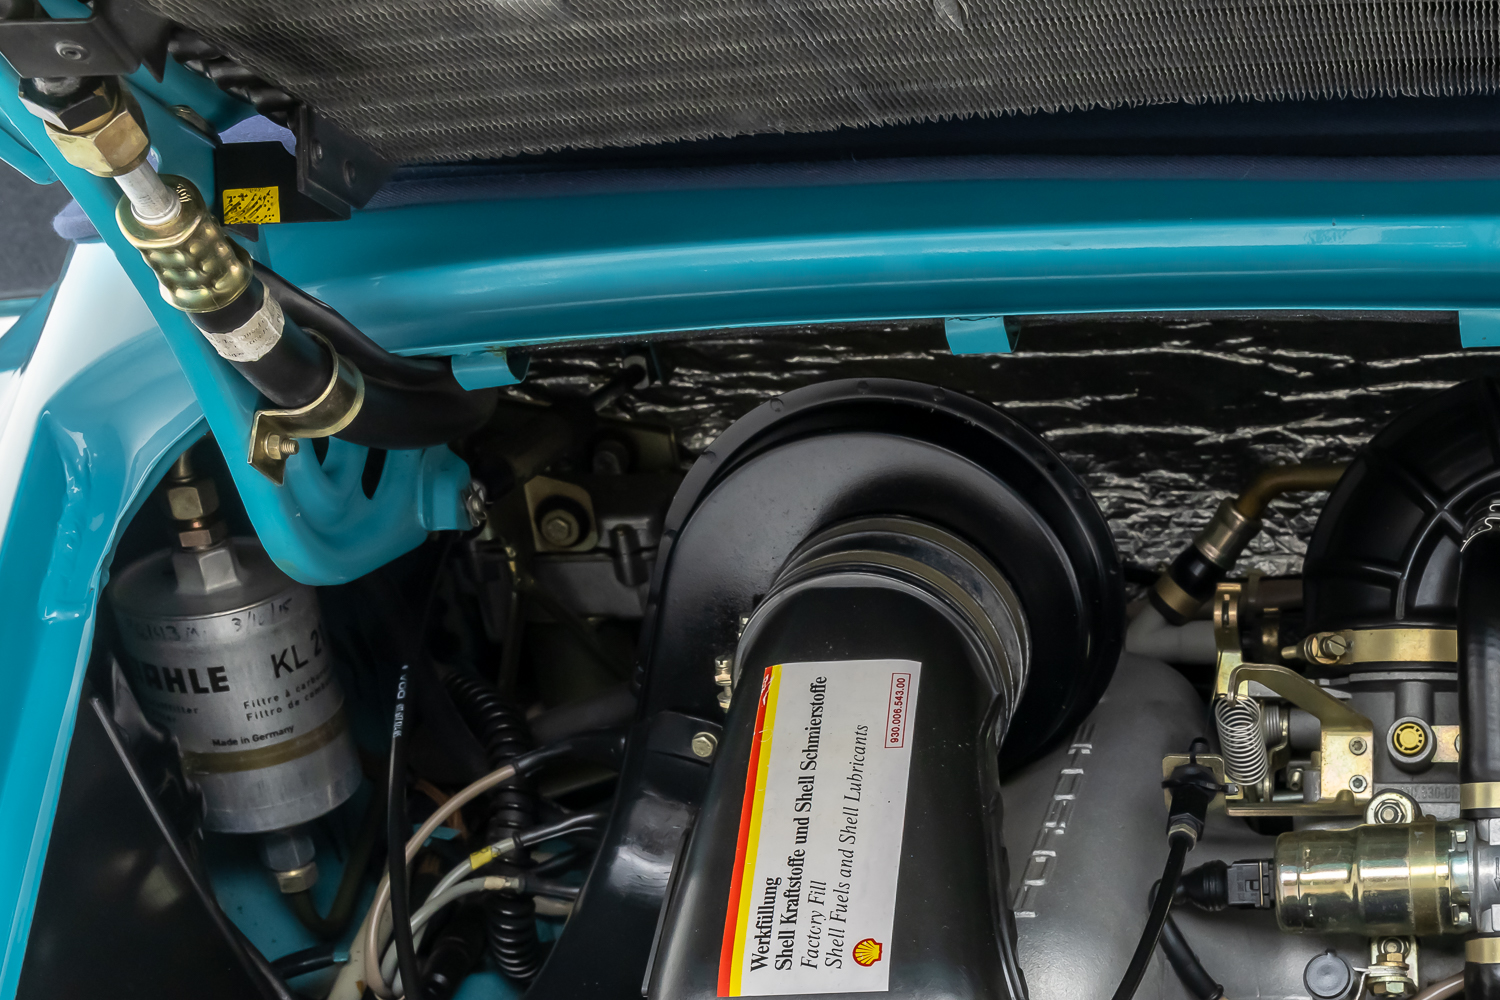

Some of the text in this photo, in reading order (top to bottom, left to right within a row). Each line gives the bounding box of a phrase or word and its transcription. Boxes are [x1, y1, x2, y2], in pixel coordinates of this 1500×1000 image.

[271, 644, 309, 679] KL
[243, 694, 279, 710] Filtre
[246, 707, 282, 722] Filtro
[252, 725, 295, 744] Germany
[890, 677, 906, 744] 930.006.543.00
[774, 675, 828, 971] Shell Kraftstoffe und Shell Schmierstoffe
[825, 724, 870, 970] Shell Fuels and Shell Lubricants
[750, 877, 783, 973] Werkfüllung
[800, 880, 828, 970] Factory Fill
